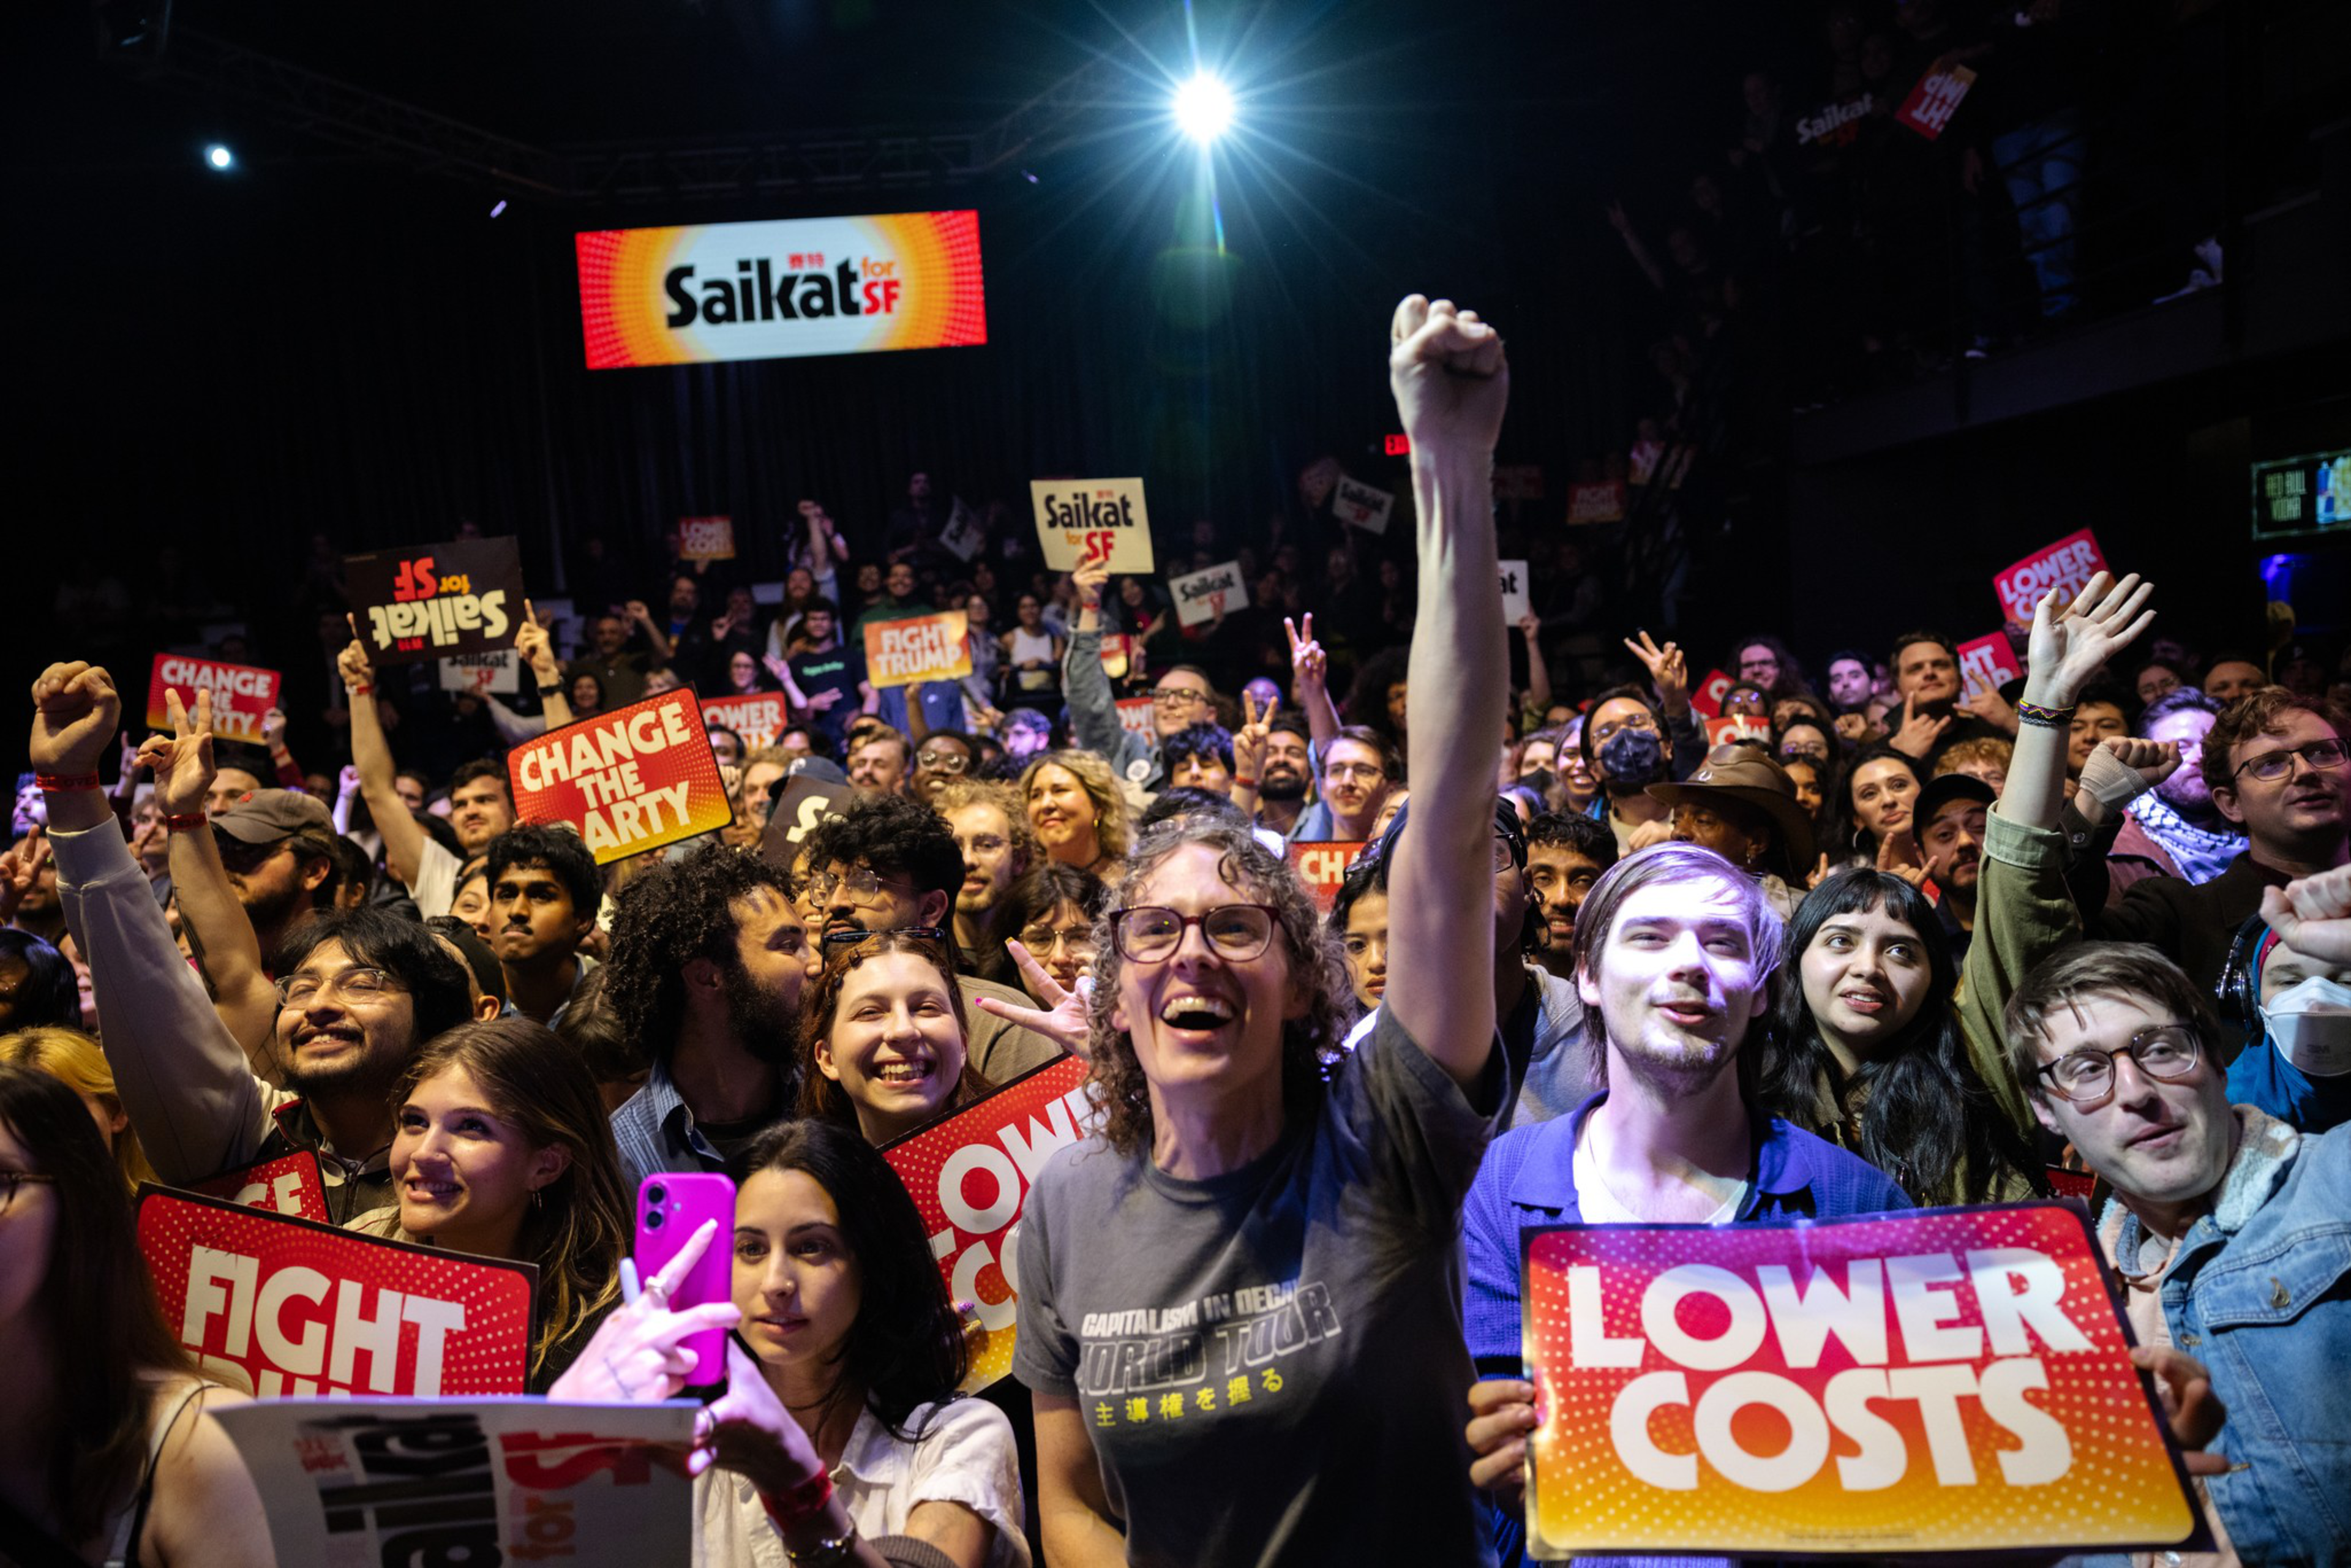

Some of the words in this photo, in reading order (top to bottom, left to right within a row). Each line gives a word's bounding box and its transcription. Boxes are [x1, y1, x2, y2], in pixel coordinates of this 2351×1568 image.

[861, 257, 896, 277] for
[664, 256, 861, 329] Saikat
[862, 279, 901, 316] SF
[1045, 492, 1134, 529] Saikat
[1086, 531, 1116, 561] SF
[393, 557, 437, 602] SF
[439, 574, 471, 595] for
[2000, 540, 2098, 606] LOWER
[368, 590, 509, 651] Saikat
[880, 623, 952, 654] FIGHT
[161, 659, 272, 698] CHANGE
[875, 644, 963, 678] TRUMP
[193, 687, 233, 711] HE
[704, 700, 782, 730] OWER
[519, 702, 691, 793] CHANGE
[576, 761, 645, 809] THE
[181, 1244, 466, 1401] FIGHT
[1081, 1300, 1199, 1337] CAPITALISM
[1204, 1292, 1231, 1322] IN
[1215, 1281, 1342, 1376] TOUR
[1567, 1245, 2095, 1372] LOWER
[1609, 1357, 2074, 1493] COSTS
[509, 1496, 578, 1561] for
